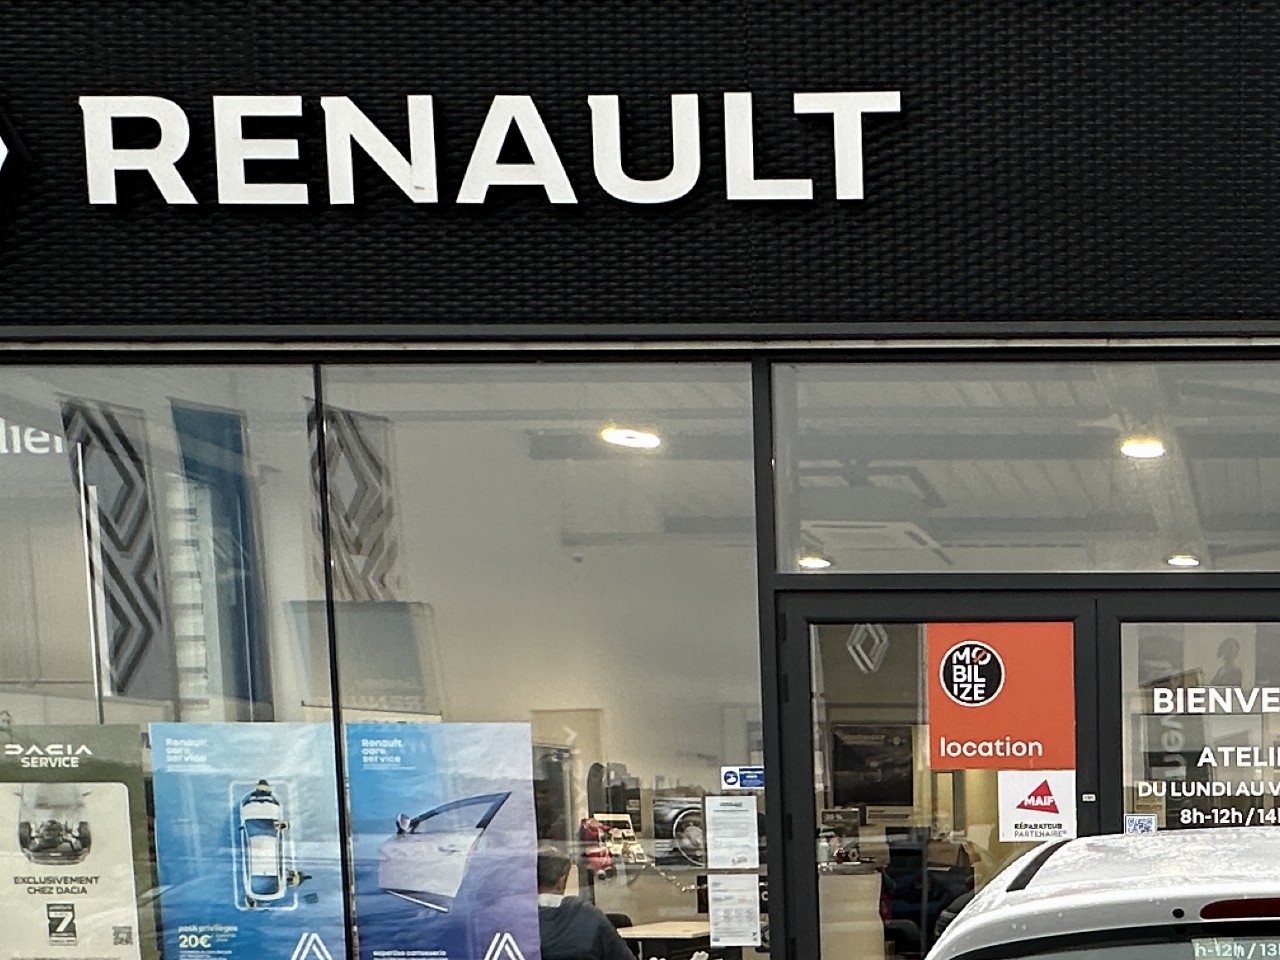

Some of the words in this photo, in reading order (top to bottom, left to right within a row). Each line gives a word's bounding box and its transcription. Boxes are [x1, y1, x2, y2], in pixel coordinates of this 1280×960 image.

[79, 91, 901, 205] RENAULT
[952, 665, 986, 683] BIL
[952, 684, 986, 701] IZE
[165, 738, 207, 747] Renault
[361, 738, 402, 748] Renault
[940, 736, 1043, 757] location
[5, 744, 92, 755] DACIA
[21, 757, 79, 768] SERVICE
[166, 755, 207, 763] service
[363, 755, 401, 763] service
[1138, 781, 1167, 797] DU
[1171, 781, 1232, 797] LUNDI
[1235, 782, 1266, 797] AU
[1023, 796, 1055, 807] MAIF
[1180, 808, 1243, 825] 8h-12h
[1014, 822, 1062, 830] RÉPARATEUR
[13, 875, 100, 885] EXCLUSIVEMENT
[27, 886, 54, 895] CHEZ
[56, 886, 88, 895] DACIA
[49, 911, 73, 932] 7
[178, 934, 213, 948] 20€
